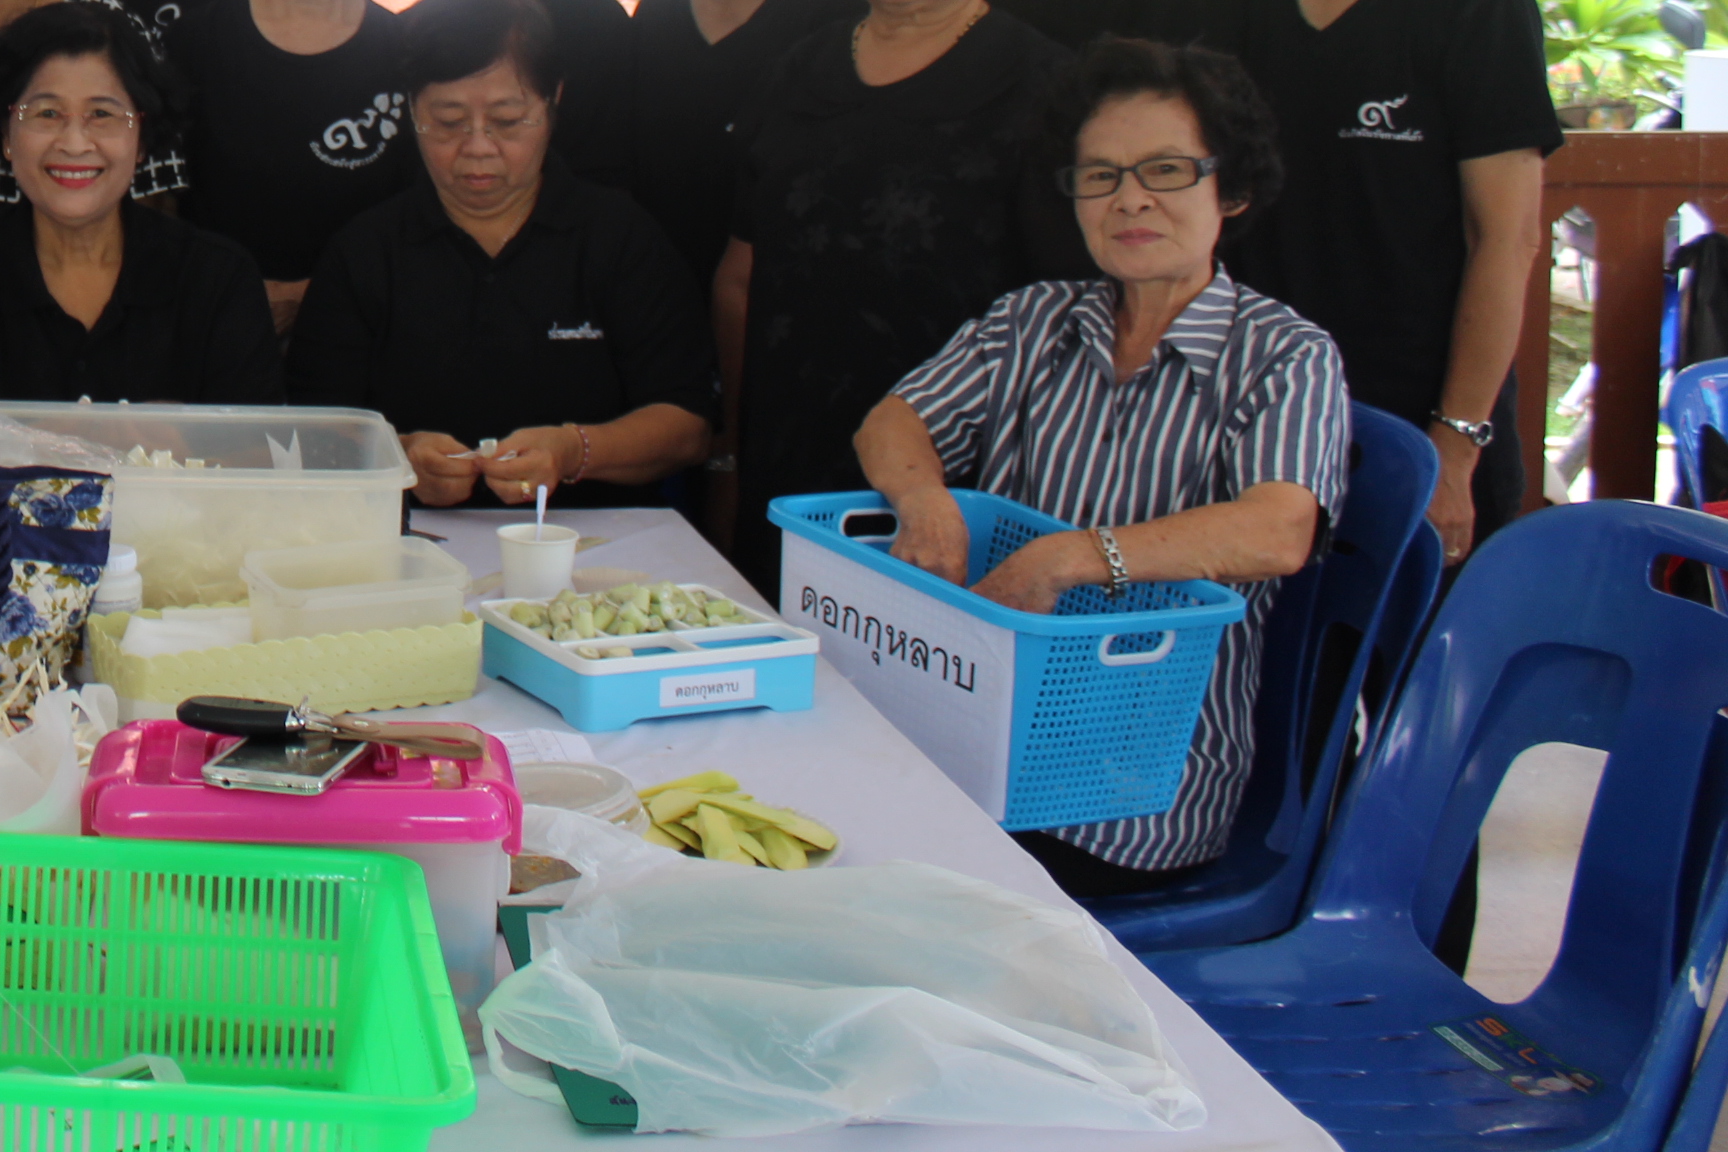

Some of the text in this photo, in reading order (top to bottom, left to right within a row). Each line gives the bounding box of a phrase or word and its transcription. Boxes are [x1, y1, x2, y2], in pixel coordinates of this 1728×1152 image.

[801, 586, 975, 692] ดอกกุหลาบ
[675, 681, 739, 700] ดอกกุหลาบ
